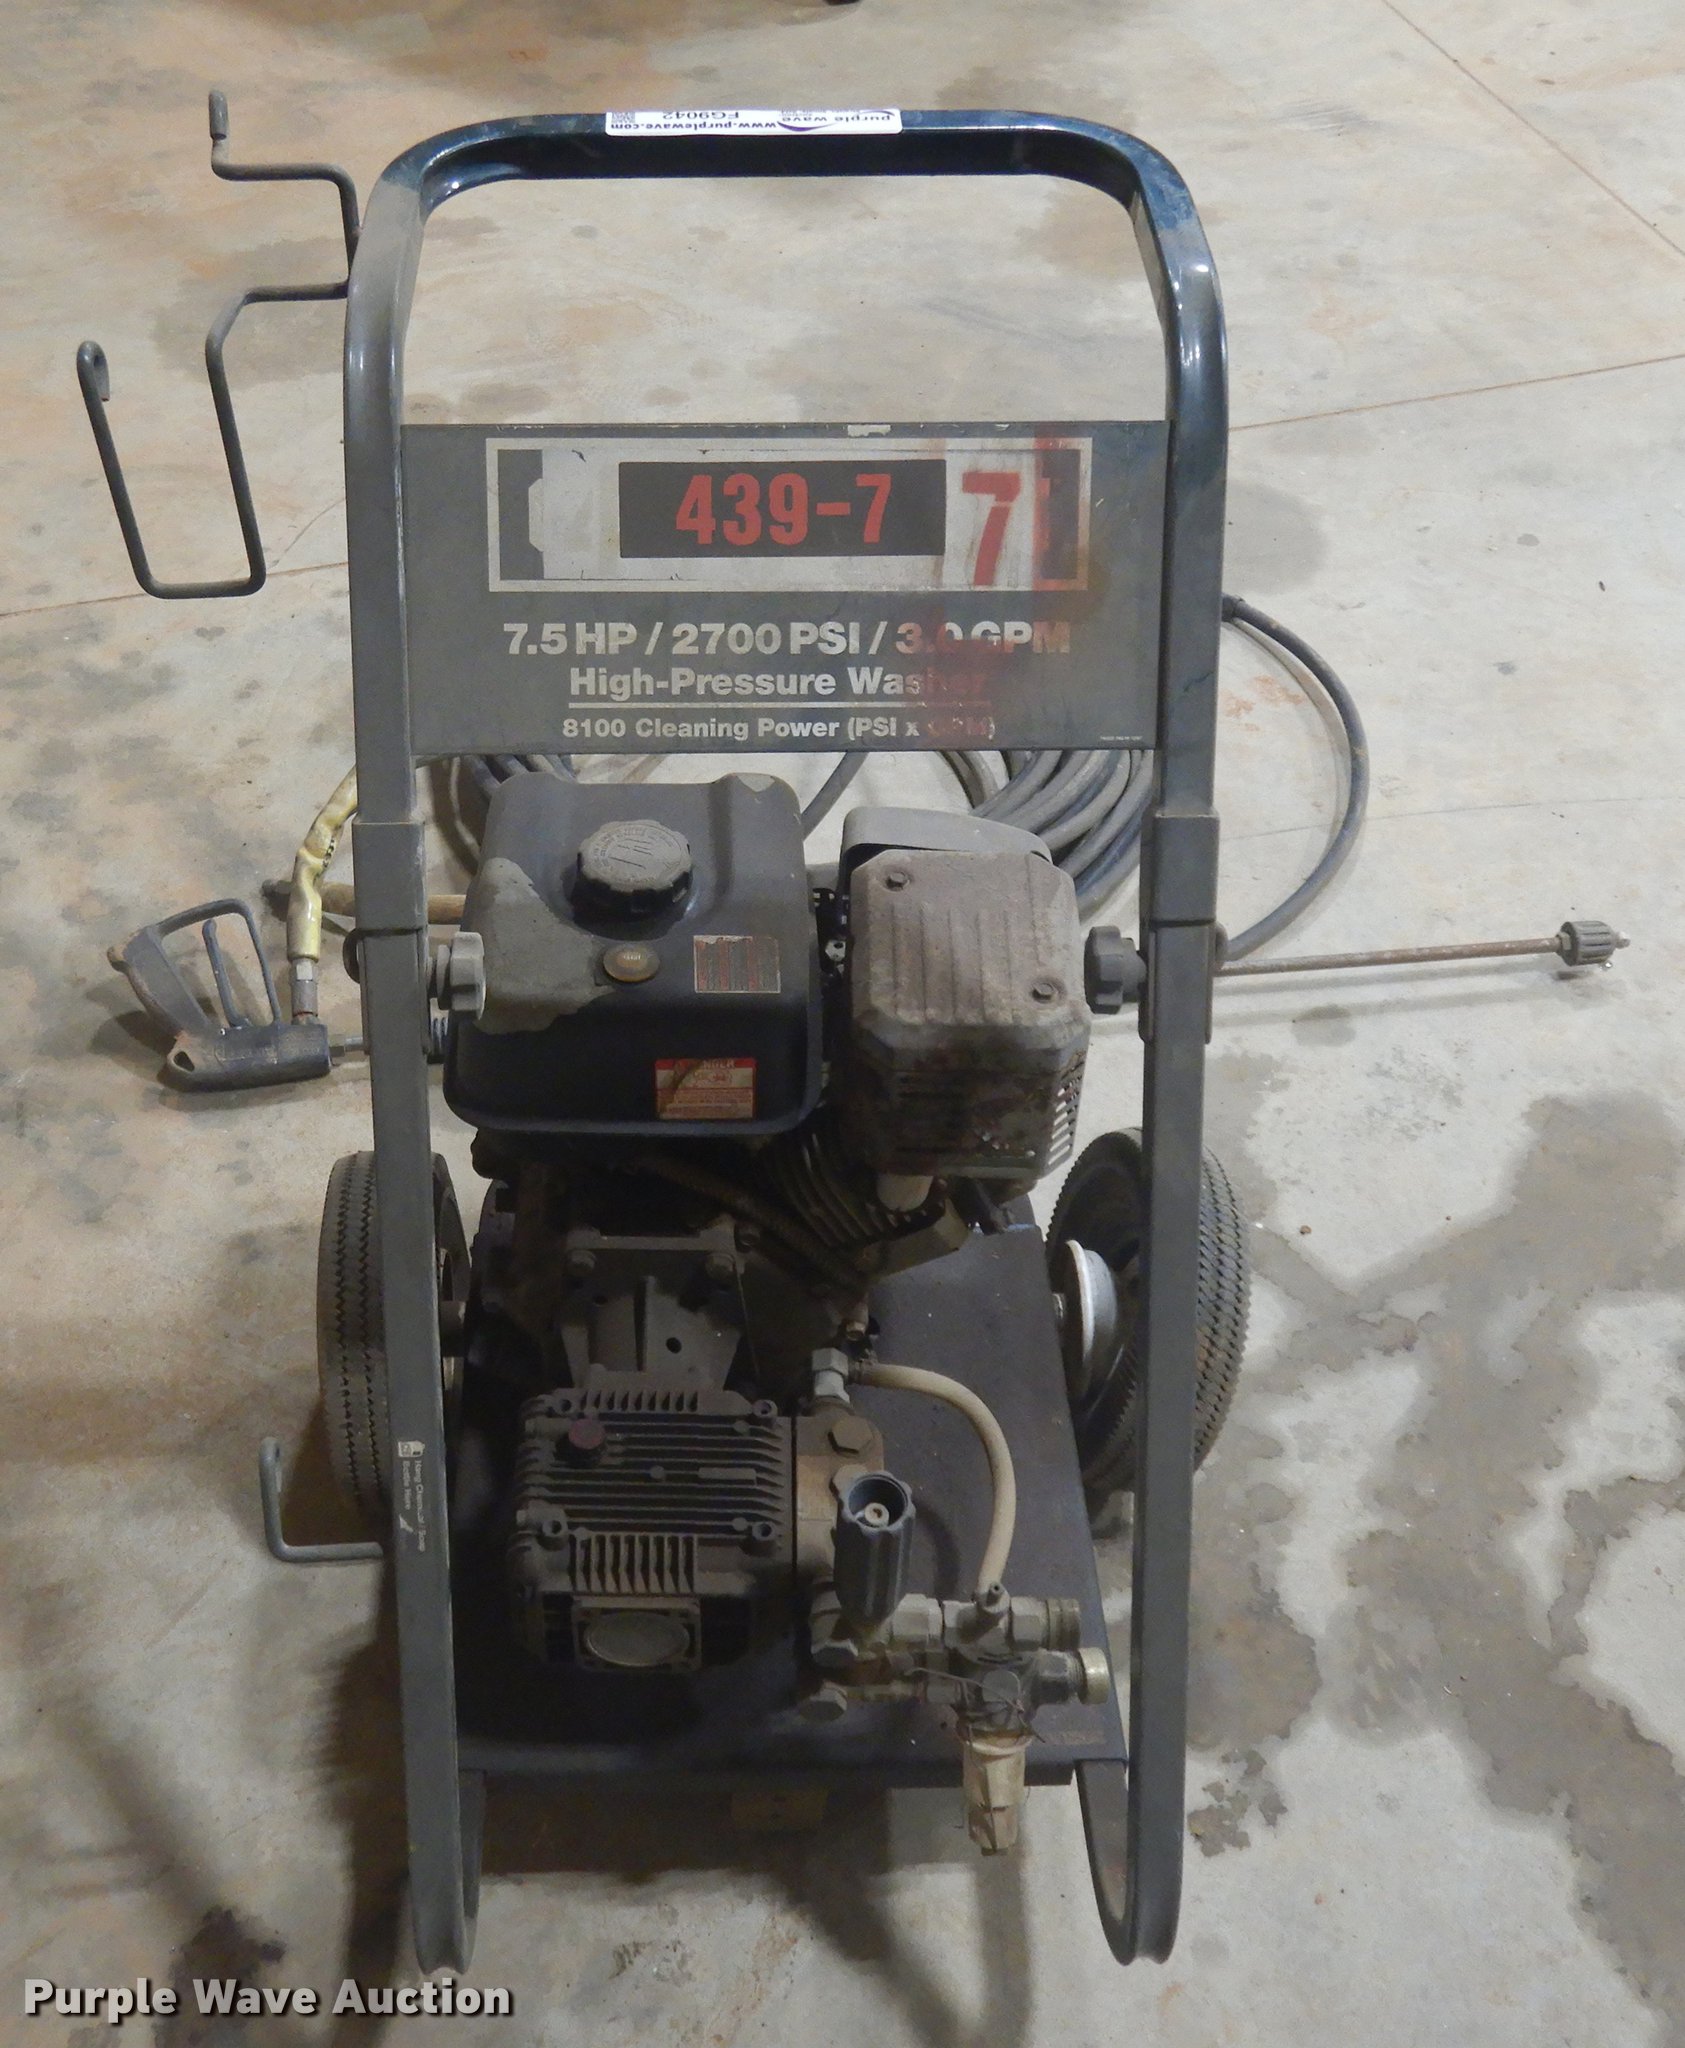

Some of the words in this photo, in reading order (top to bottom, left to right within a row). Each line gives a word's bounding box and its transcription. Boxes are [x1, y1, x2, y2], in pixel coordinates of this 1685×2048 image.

[610, 121, 776, 130] www.purplewave.com
[662, 111, 740, 120] FG9042
[834, 114, 890, 122] purple
[675, 472, 892, 546] 439-7
[961, 471, 1021, 586] 7
[503, 622, 568, 655] 7.5
[575, 621, 638, 654] HP
[644, 621, 664, 656] /
[671, 622, 782, 655] 2700
[789, 621, 861, 655] PSI
[867, 621, 888, 655] /
[895, 621, 964, 655] 3.0
[970, 621, 1071, 654] GPM
[569, 667, 837, 701] High-Pressure
[562, 718, 626, 738] 8100
[635, 717, 749, 740] Cleaning
[757, 717, 840, 738] Power
[847, 716, 897, 741] (PSI
[904, 721, 920, 738] x
